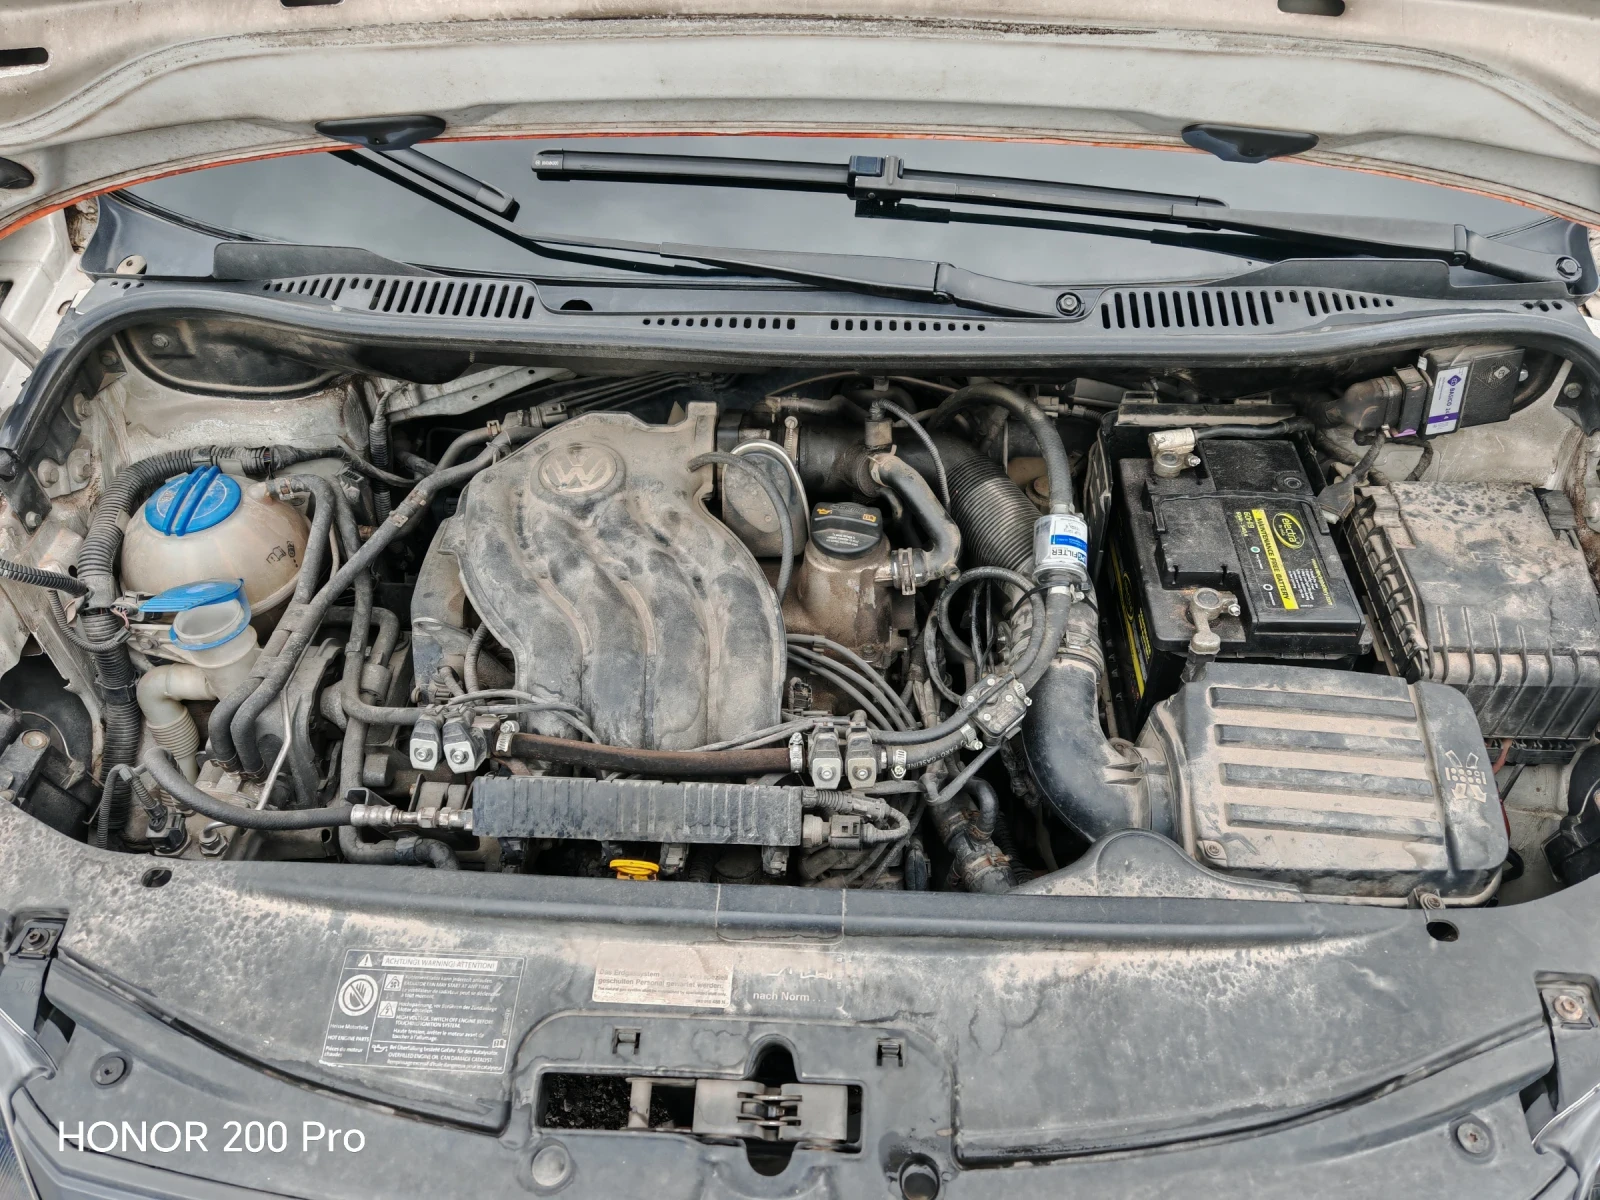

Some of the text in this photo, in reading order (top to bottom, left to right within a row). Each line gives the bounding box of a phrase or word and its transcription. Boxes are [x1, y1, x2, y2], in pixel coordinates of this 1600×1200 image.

[1446, 387, 1455, 406] BASICO
[1282, 518, 1297, 543] electra
[1052, 549, 1078, 558] FILTER
[1256, 518, 1275, 557] MAINTENANCE
[1270, 557, 1280, 572] FREE
[1276, 573, 1290, 600] BATTERY
[385, 957, 495, 970] ACHTUNG! WARNING! ATTENTION!
[753, 992, 778, 1000] nach
[781, 991, 810, 1002] Norm
